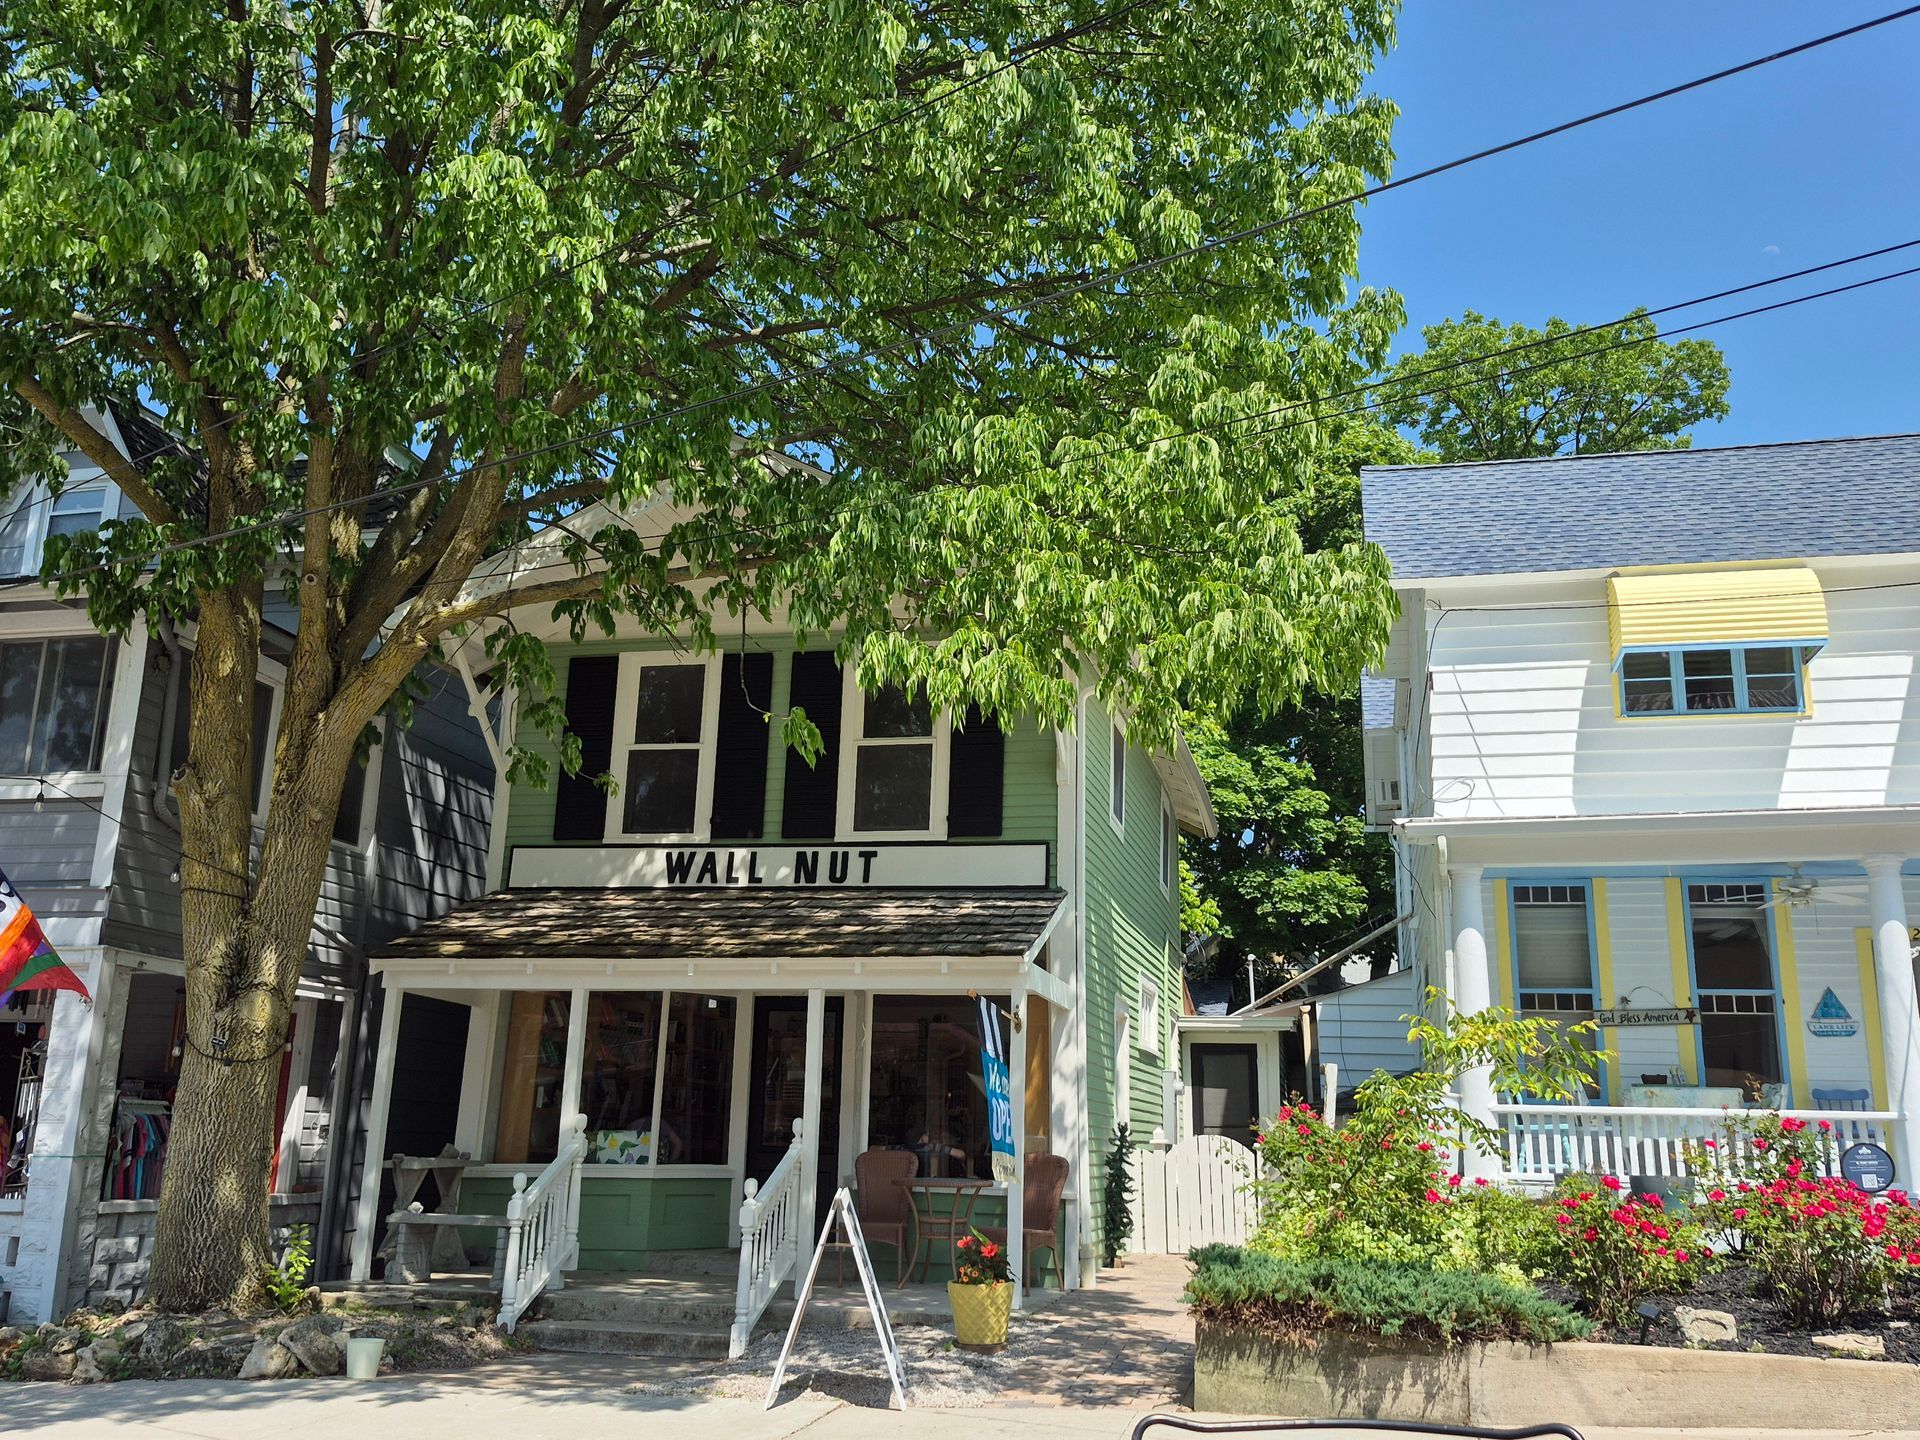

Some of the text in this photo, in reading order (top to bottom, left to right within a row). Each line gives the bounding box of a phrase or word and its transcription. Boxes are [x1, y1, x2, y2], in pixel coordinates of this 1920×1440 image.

[665, 851, 878, 884] WALL NUT
[1599, 1011, 1680, 1024] God Bless America
[988, 1062, 1001, 1093] We
